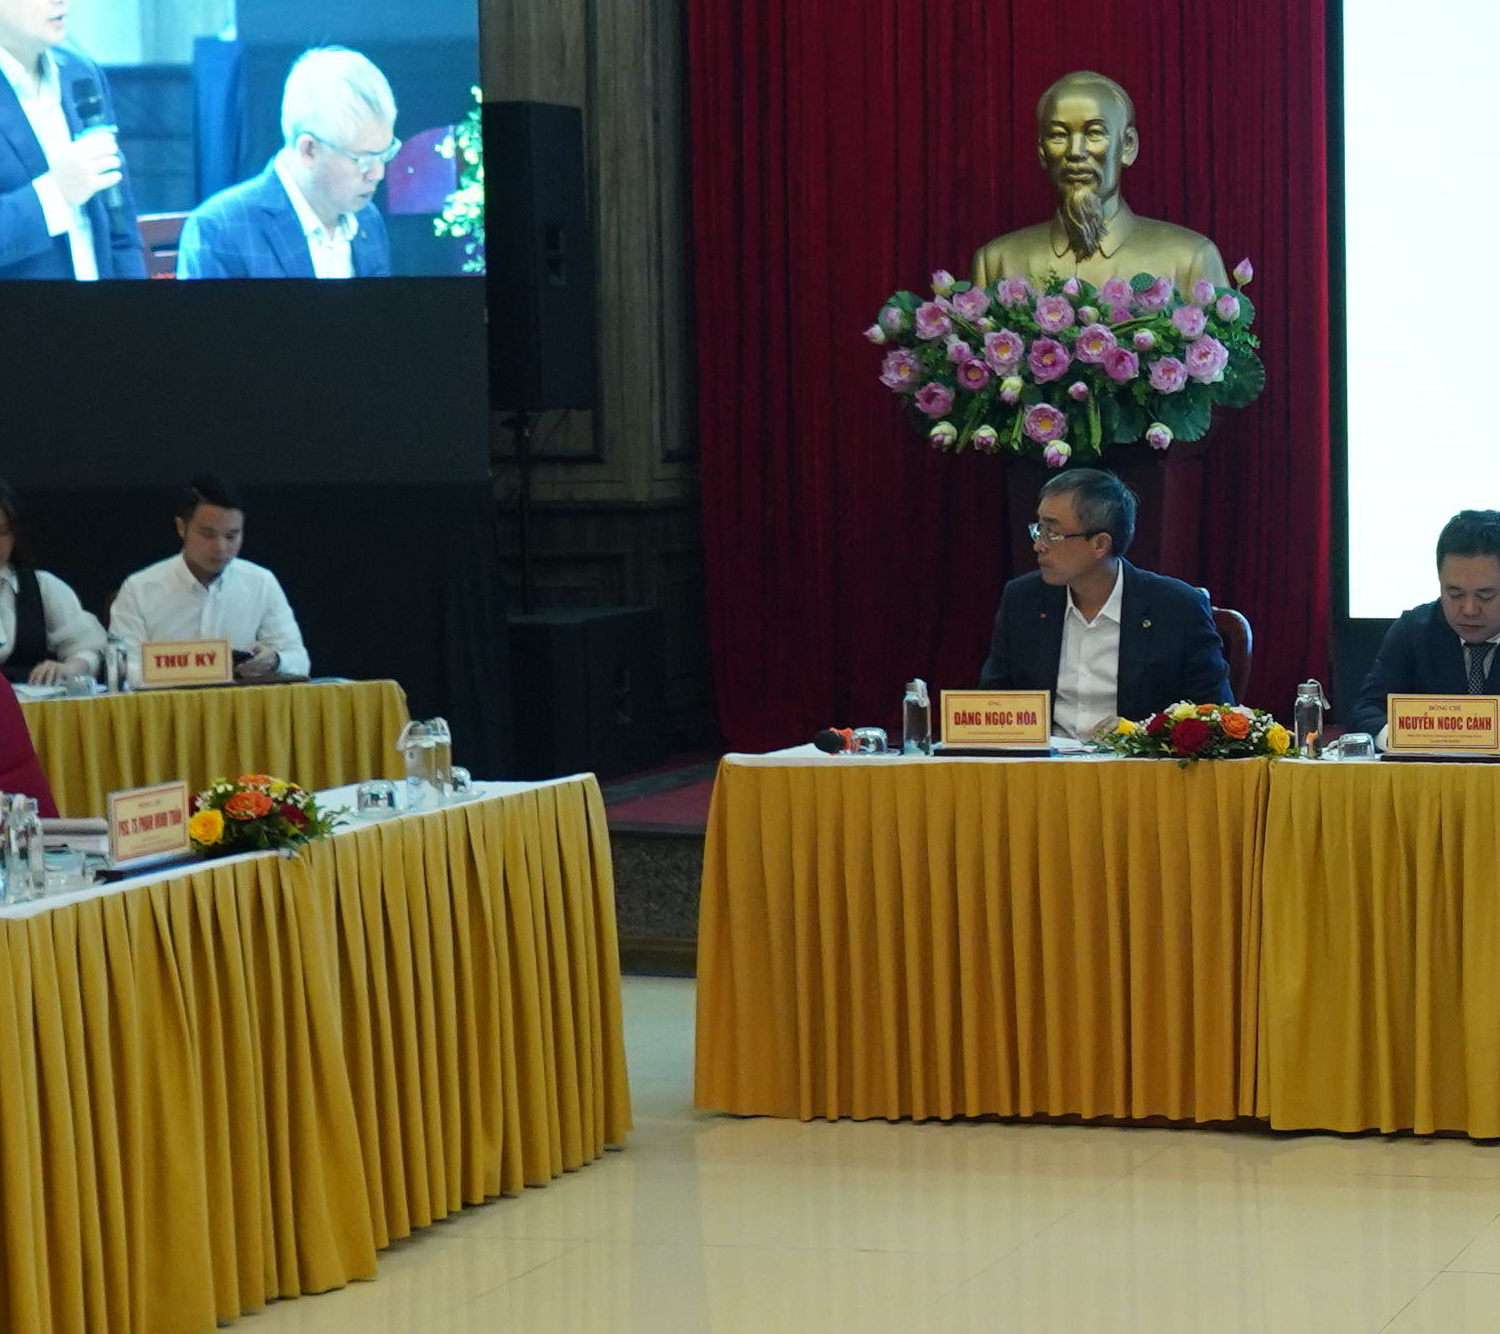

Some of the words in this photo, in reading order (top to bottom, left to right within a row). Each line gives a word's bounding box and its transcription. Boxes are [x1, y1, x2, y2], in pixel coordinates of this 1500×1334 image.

[154, 651, 191, 668] THƯ
[195, 650, 217, 667] KÝ
[984, 712, 1013, 728] NGỌC
[1398, 712, 1435, 730] NGUYỄN
[1438, 716, 1463, 732] NGỌC
[1466, 713, 1492, 730] CẢNH
